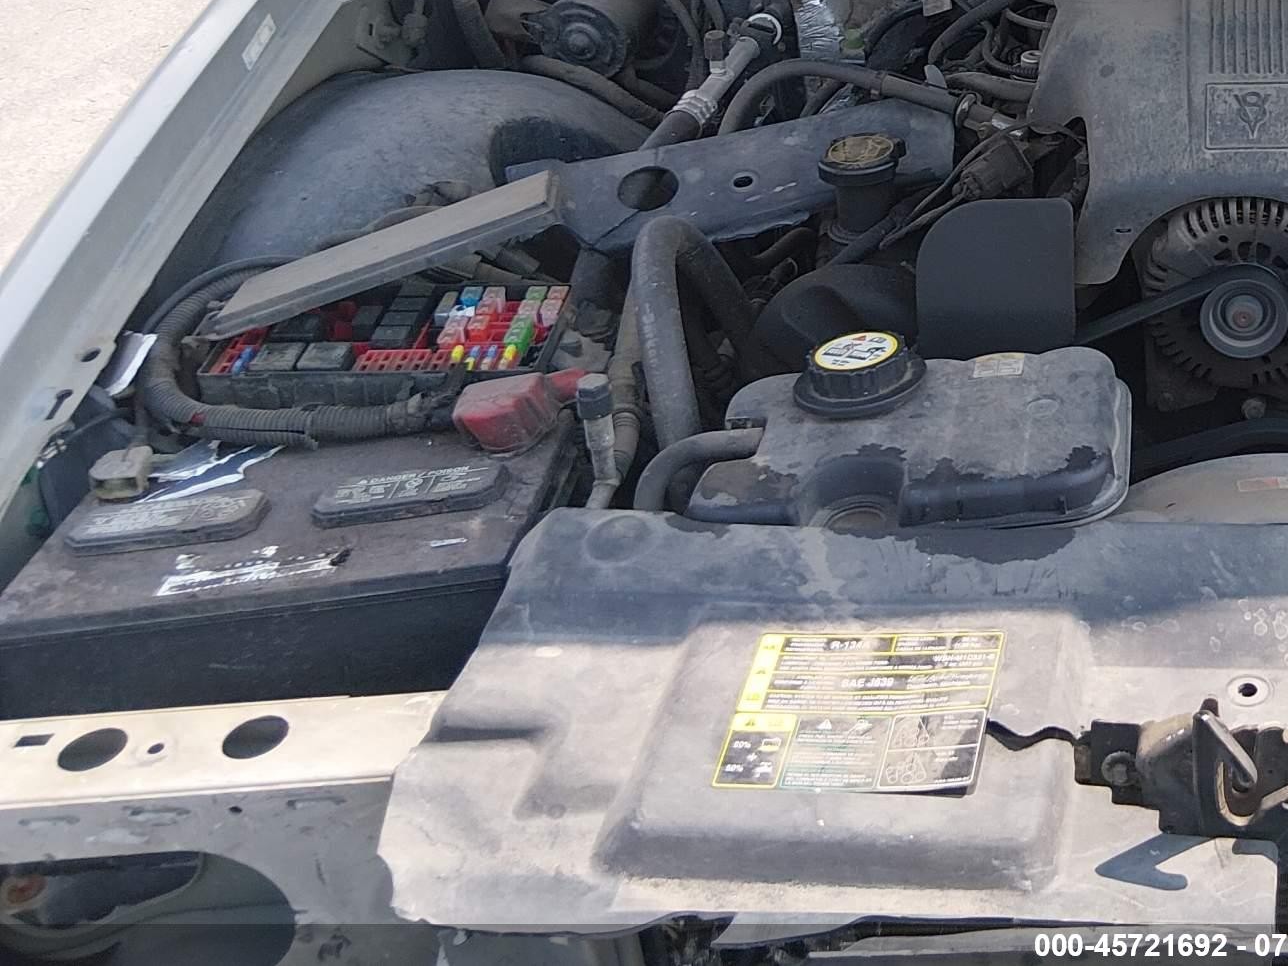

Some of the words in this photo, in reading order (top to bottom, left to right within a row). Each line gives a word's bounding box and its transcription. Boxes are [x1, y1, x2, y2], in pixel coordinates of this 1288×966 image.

[1232, 90, 1273, 140] V8
[369, 472, 417, 484] DANGER
[427, 465, 470, 476] POISON
